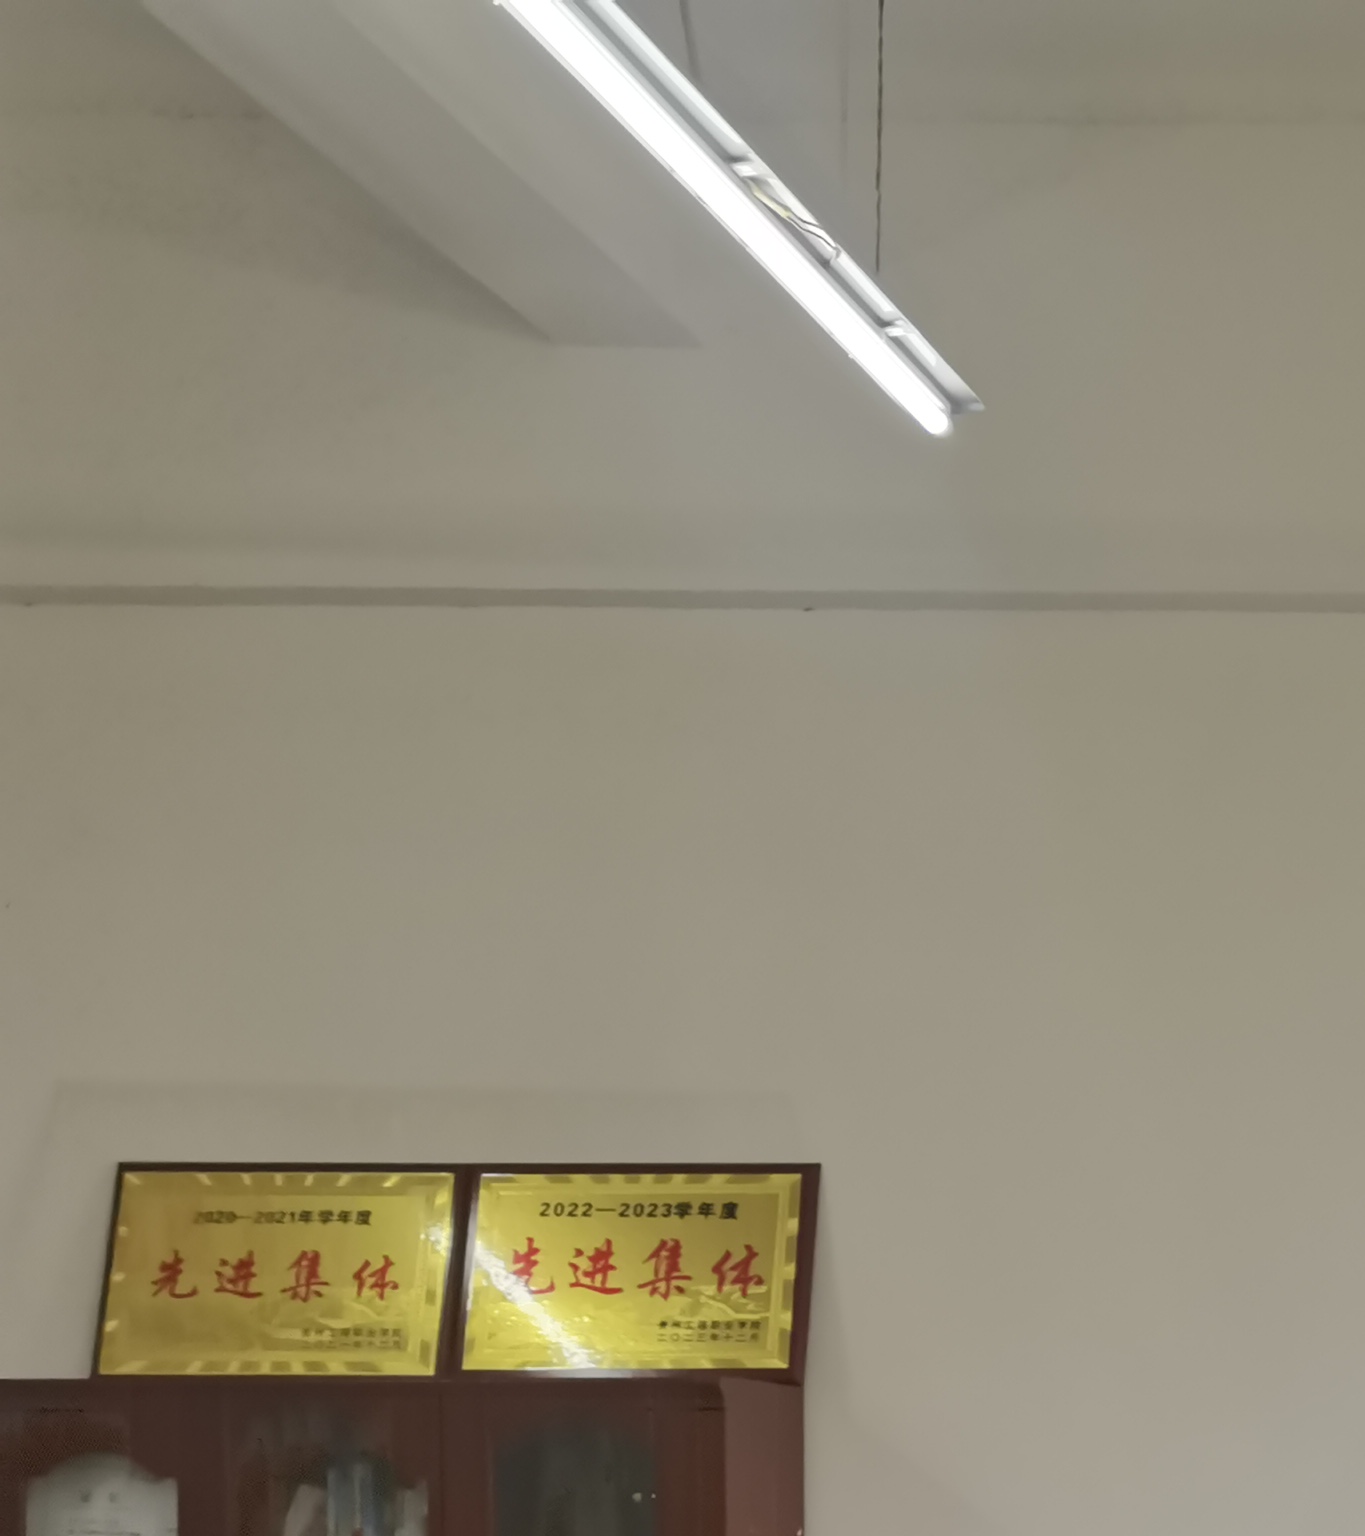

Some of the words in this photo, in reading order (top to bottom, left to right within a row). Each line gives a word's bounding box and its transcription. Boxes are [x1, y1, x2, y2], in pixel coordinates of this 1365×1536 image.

[151, 1249, 399, 1302] 先进集体
[511, 1237, 764, 1300] 先进集体
